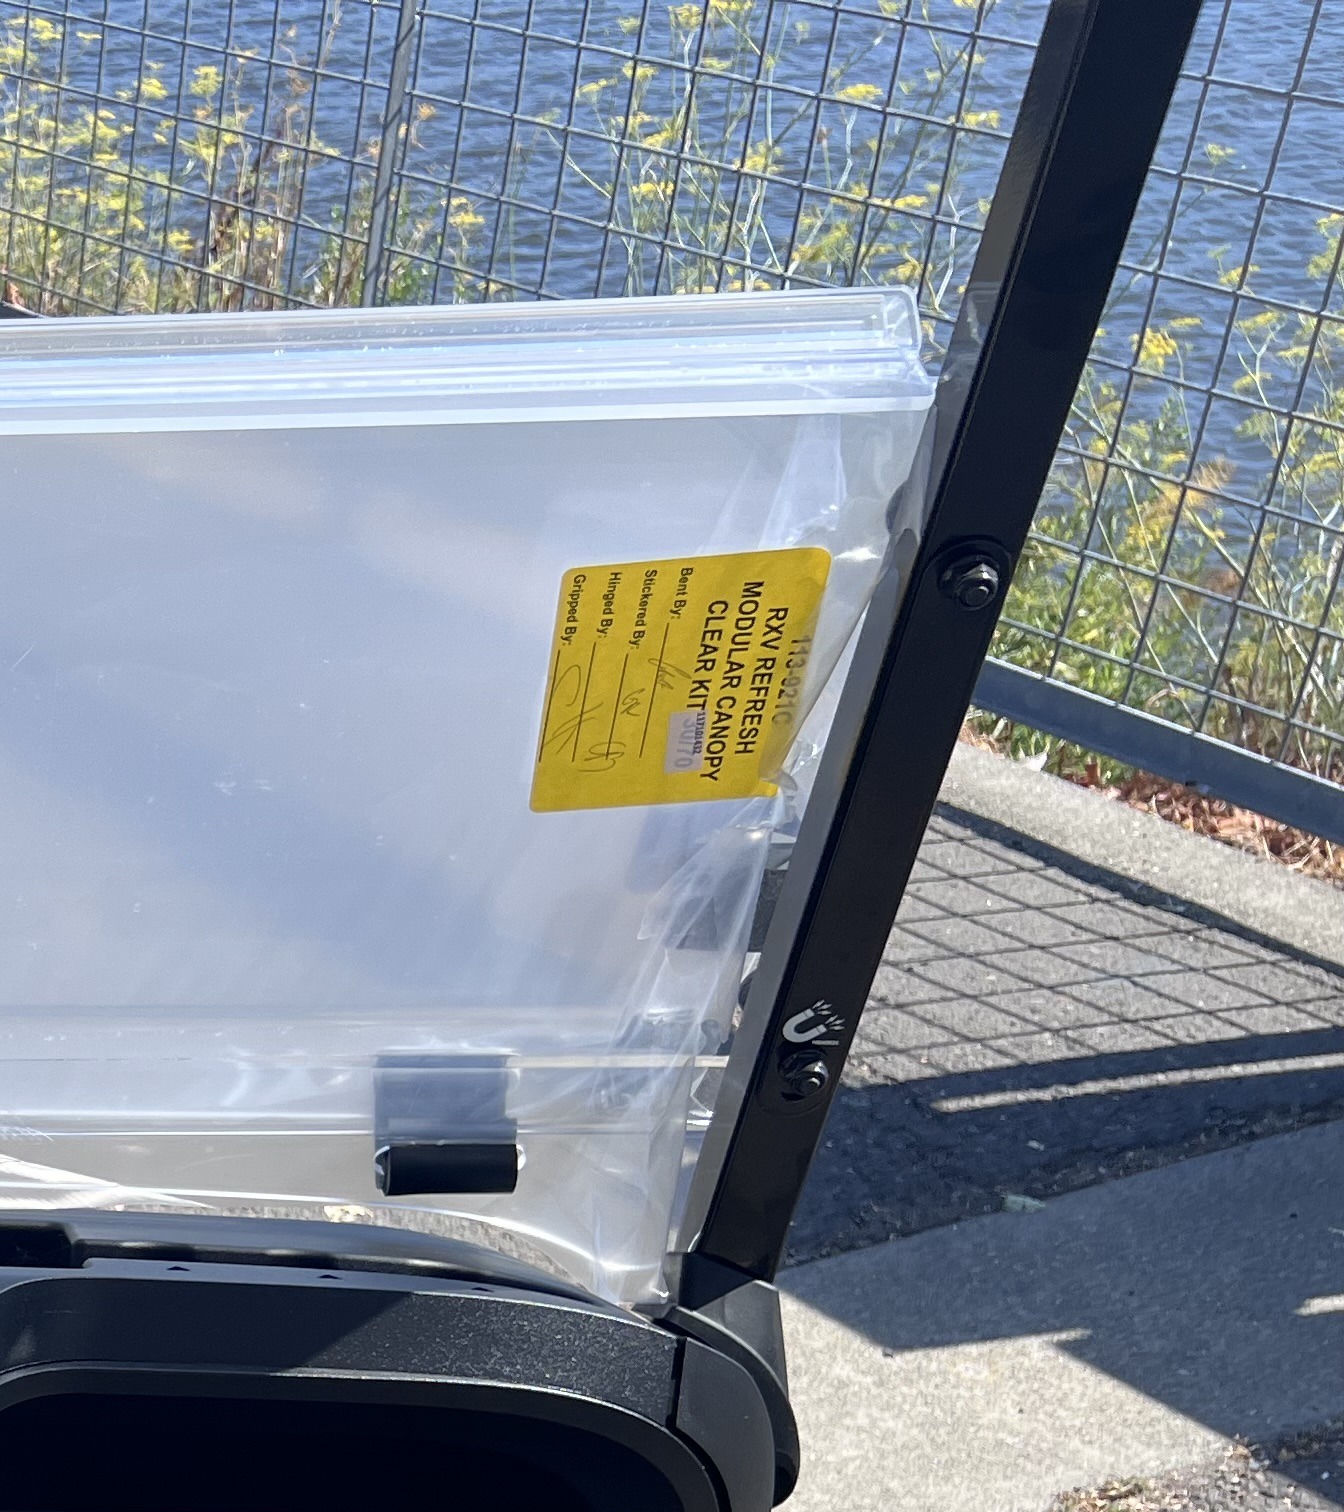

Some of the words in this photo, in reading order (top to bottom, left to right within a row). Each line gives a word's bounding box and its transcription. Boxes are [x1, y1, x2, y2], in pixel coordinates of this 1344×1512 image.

[566, 574, 587, 623] Gripped
[602, 571, 623, 615] Hinged
[634, 569, 658, 627] Stickered
[675, 567, 694, 597] Bent
[596, 618, 613, 639] By:
[669, 599, 687, 620] By:
[760, 607, 789, 651] RXV
[560, 626, 578, 647] By:
[628, 630, 646, 650] By:
[694, 600, 729, 674] CLEAR
[719, 581, 765, 690] MODULAR
[686, 679, 712, 710] KIT
[734, 657, 777, 754] REFRESH
[700, 695, 737, 781] CANOPY
